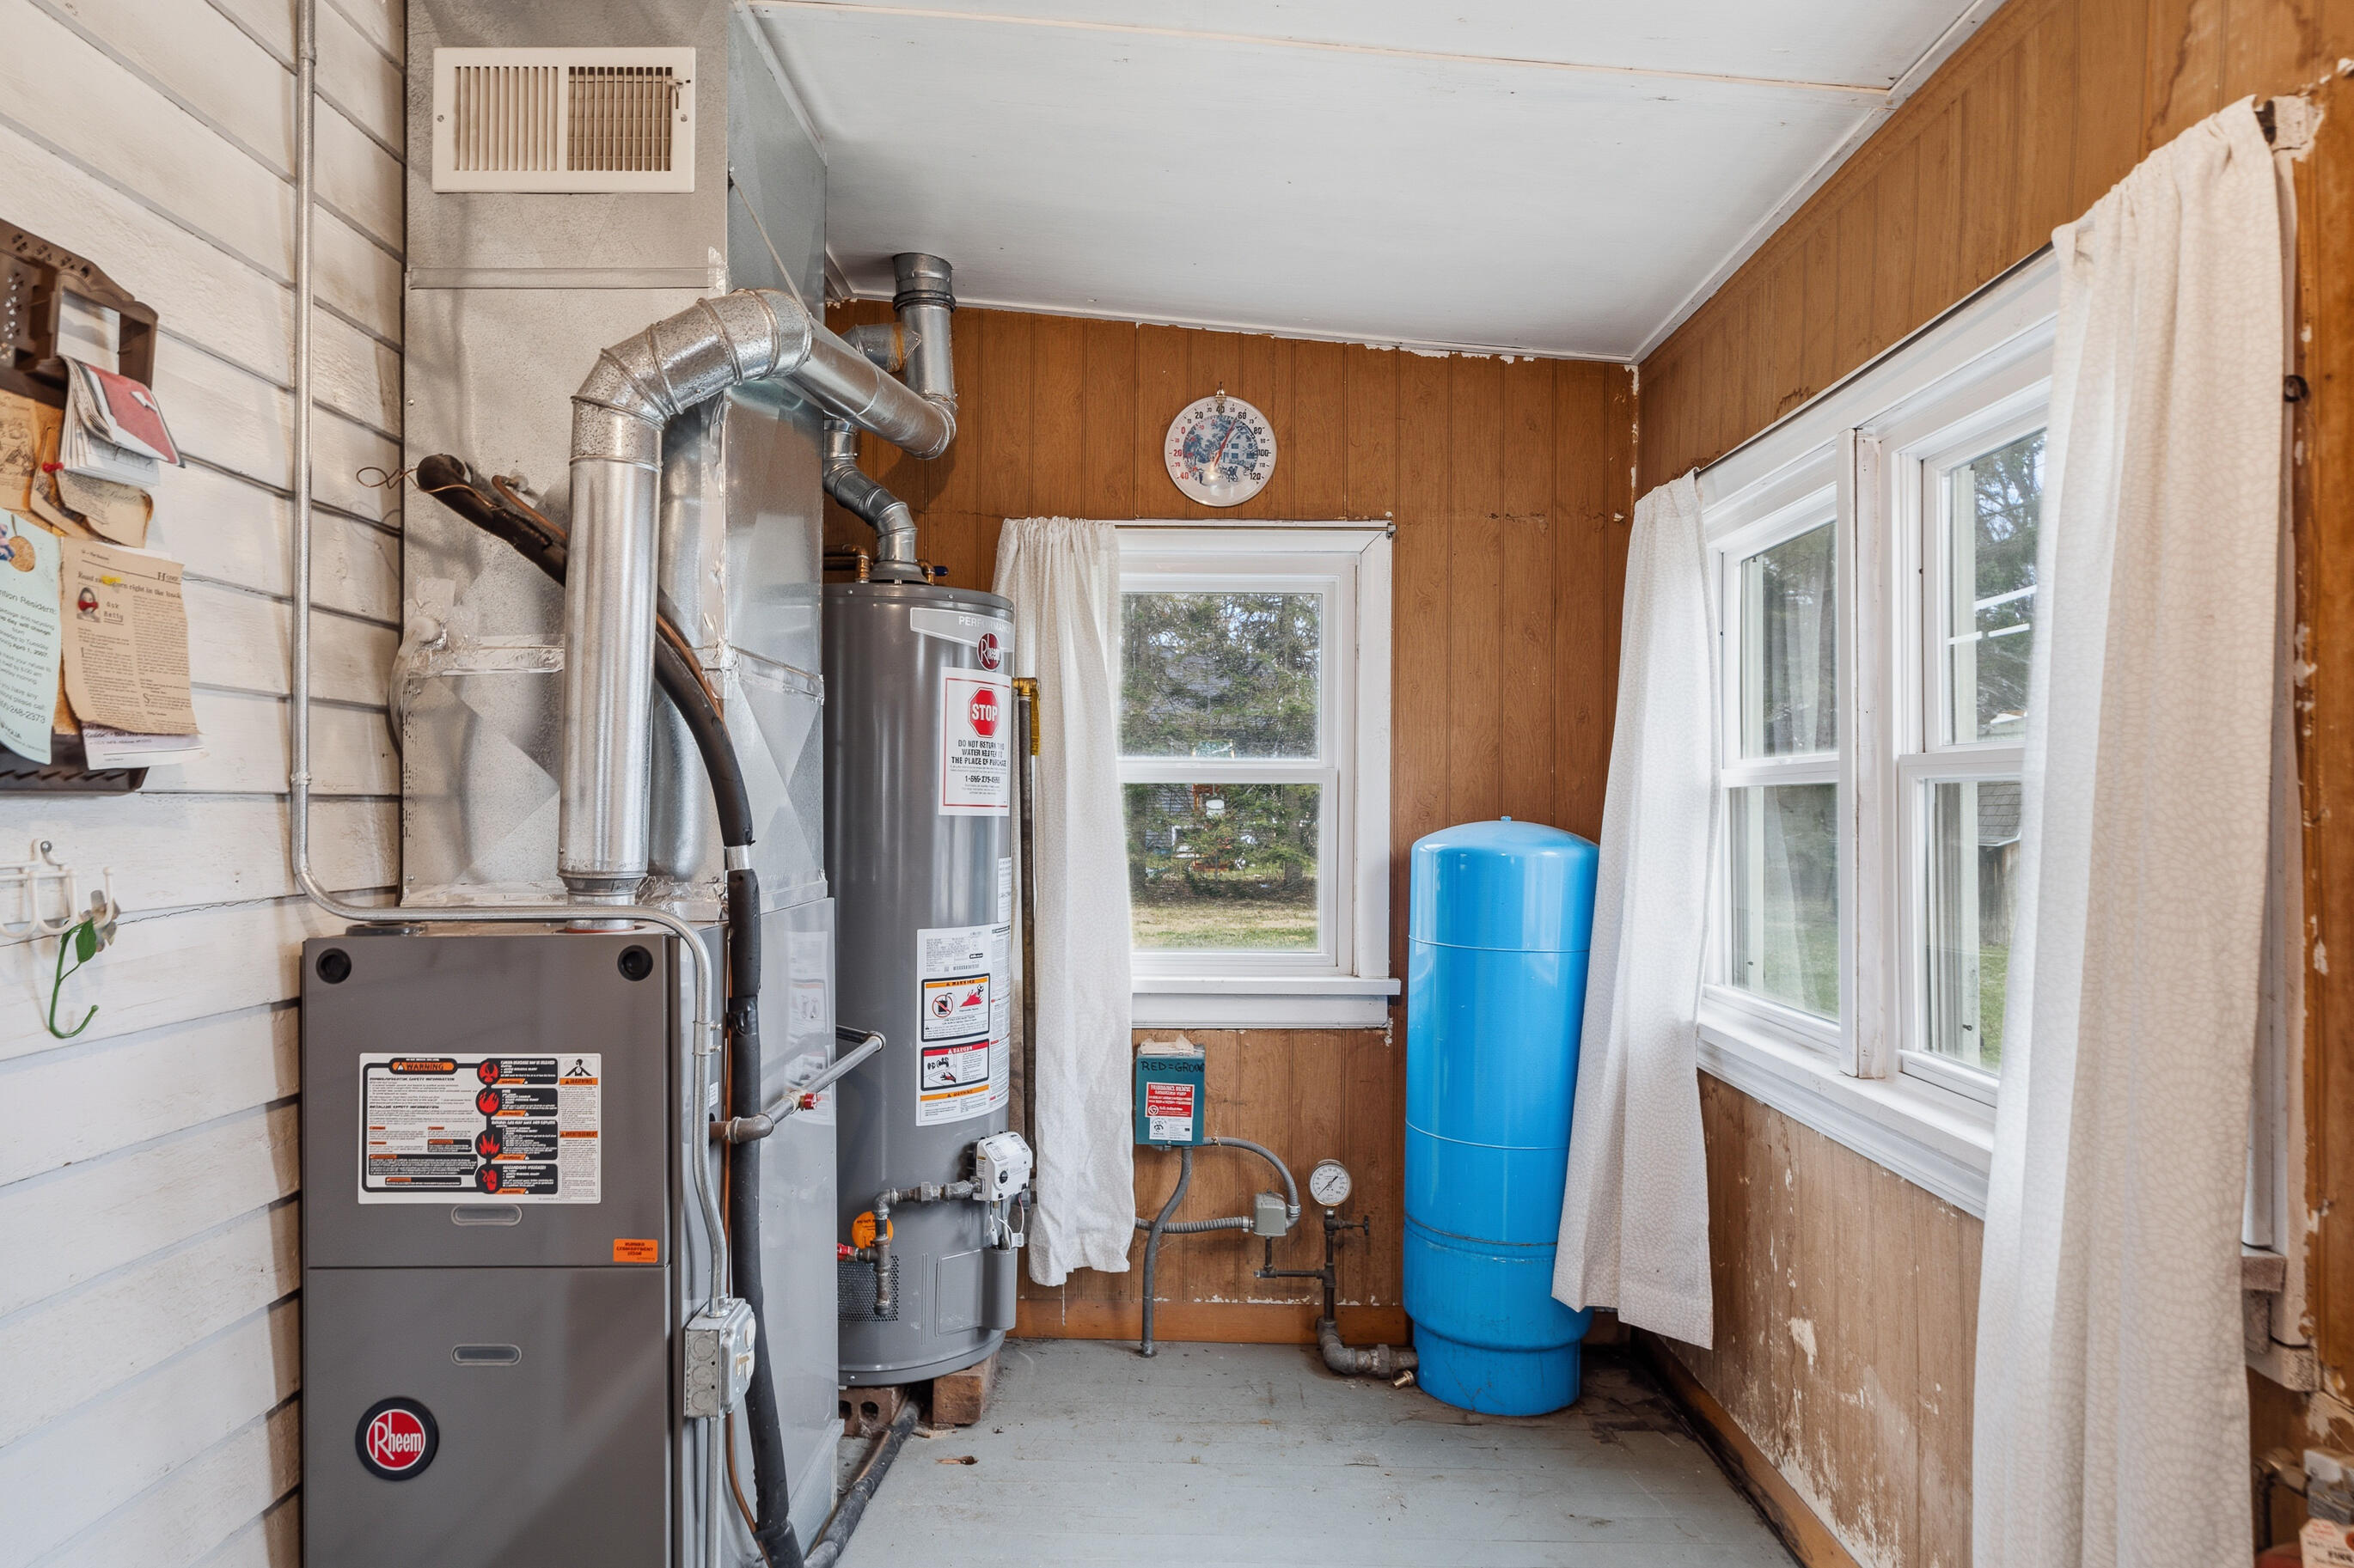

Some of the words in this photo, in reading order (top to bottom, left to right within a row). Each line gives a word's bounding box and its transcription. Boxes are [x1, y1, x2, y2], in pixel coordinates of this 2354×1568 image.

[1253, 426, 1263, 435] 80
[1250, 473, 1262, 481] 120
[971, 703, 997, 722] STOP
[957, 739, 966, 747] DO
[968, 740, 978, 748] NOT
[962, 748, 980, 757] WATER
[951, 756, 963, 765] THE
[964, 757, 981, 766] PLACE
[953, 1046, 973, 1054] DANGER
[407, 1062, 444, 1071] WARNING
[374, 1412, 422, 1461] Rheem
